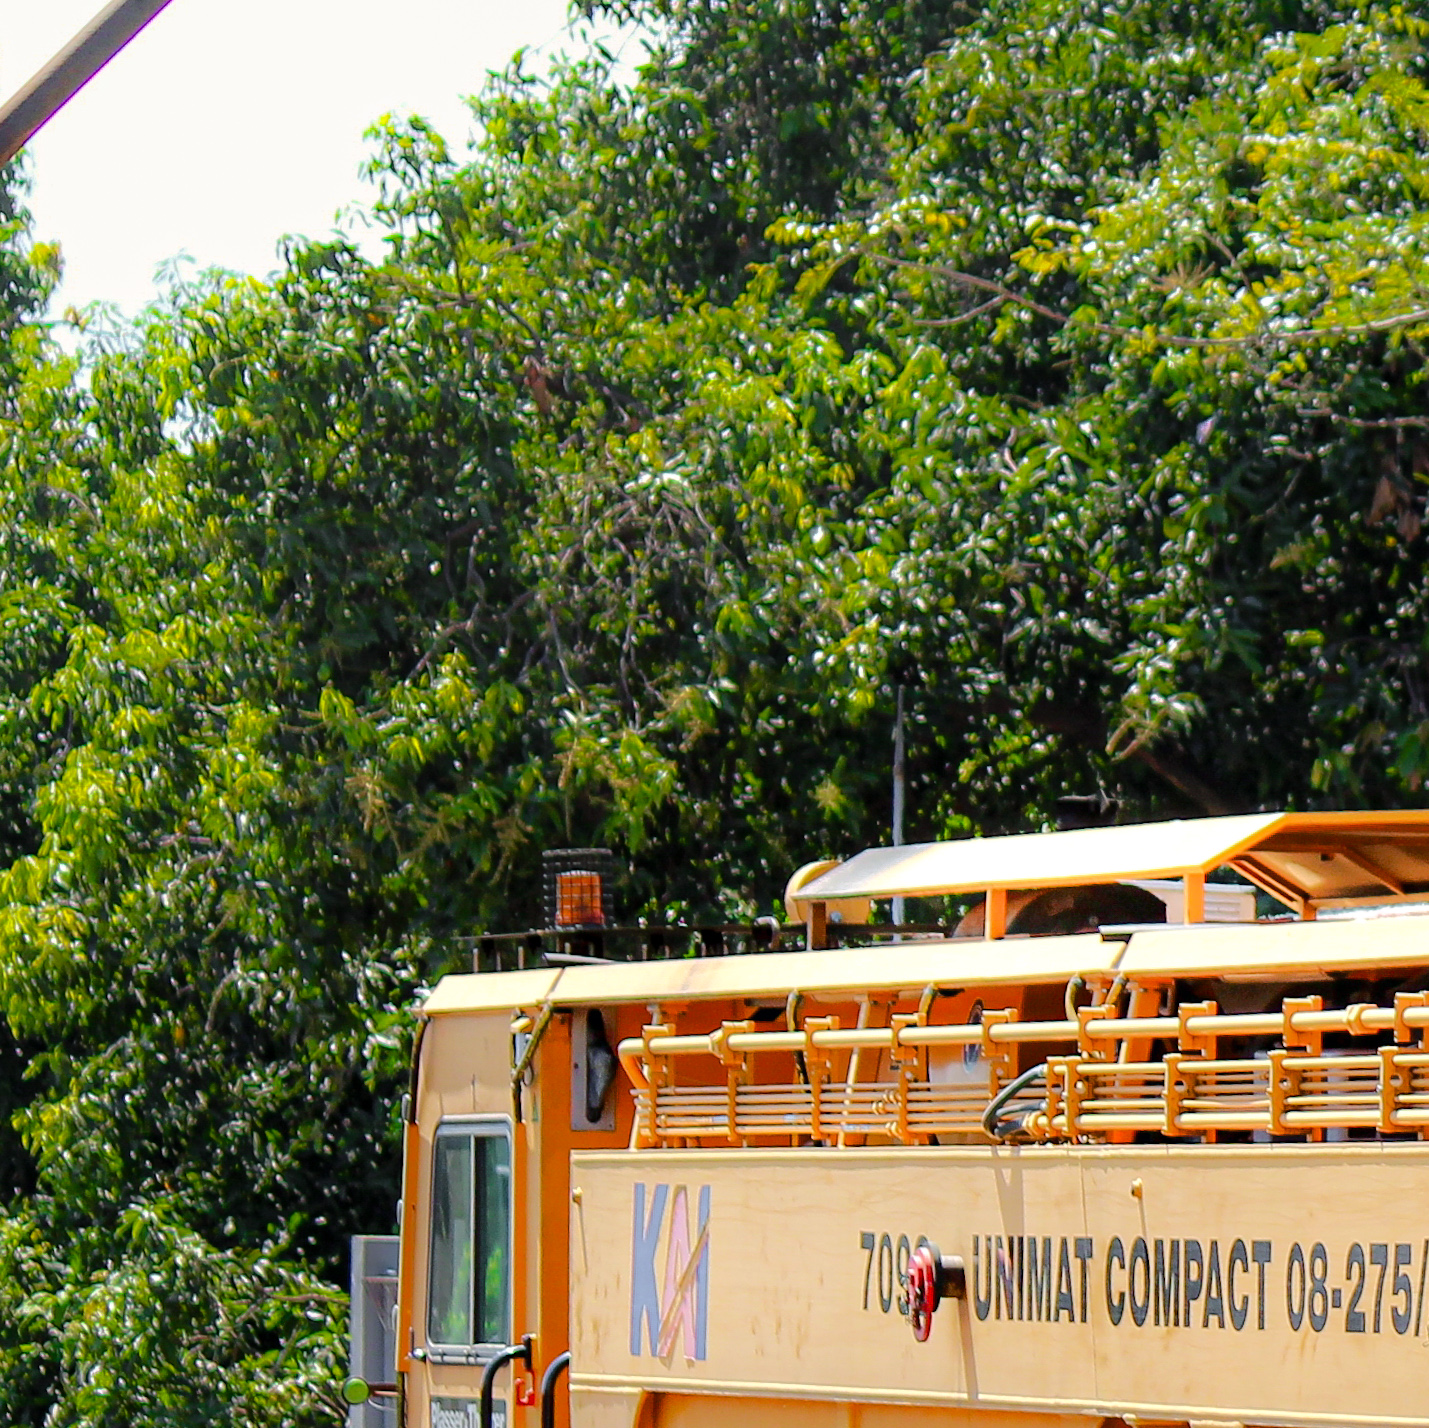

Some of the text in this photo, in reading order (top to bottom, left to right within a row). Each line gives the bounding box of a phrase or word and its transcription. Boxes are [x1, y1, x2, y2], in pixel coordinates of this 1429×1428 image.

[860, 1231, 929, 1315] 709
[972, 1235, 1093, 1322] UNIMAT
[1106, 1236, 1272, 1331] COMPACT
